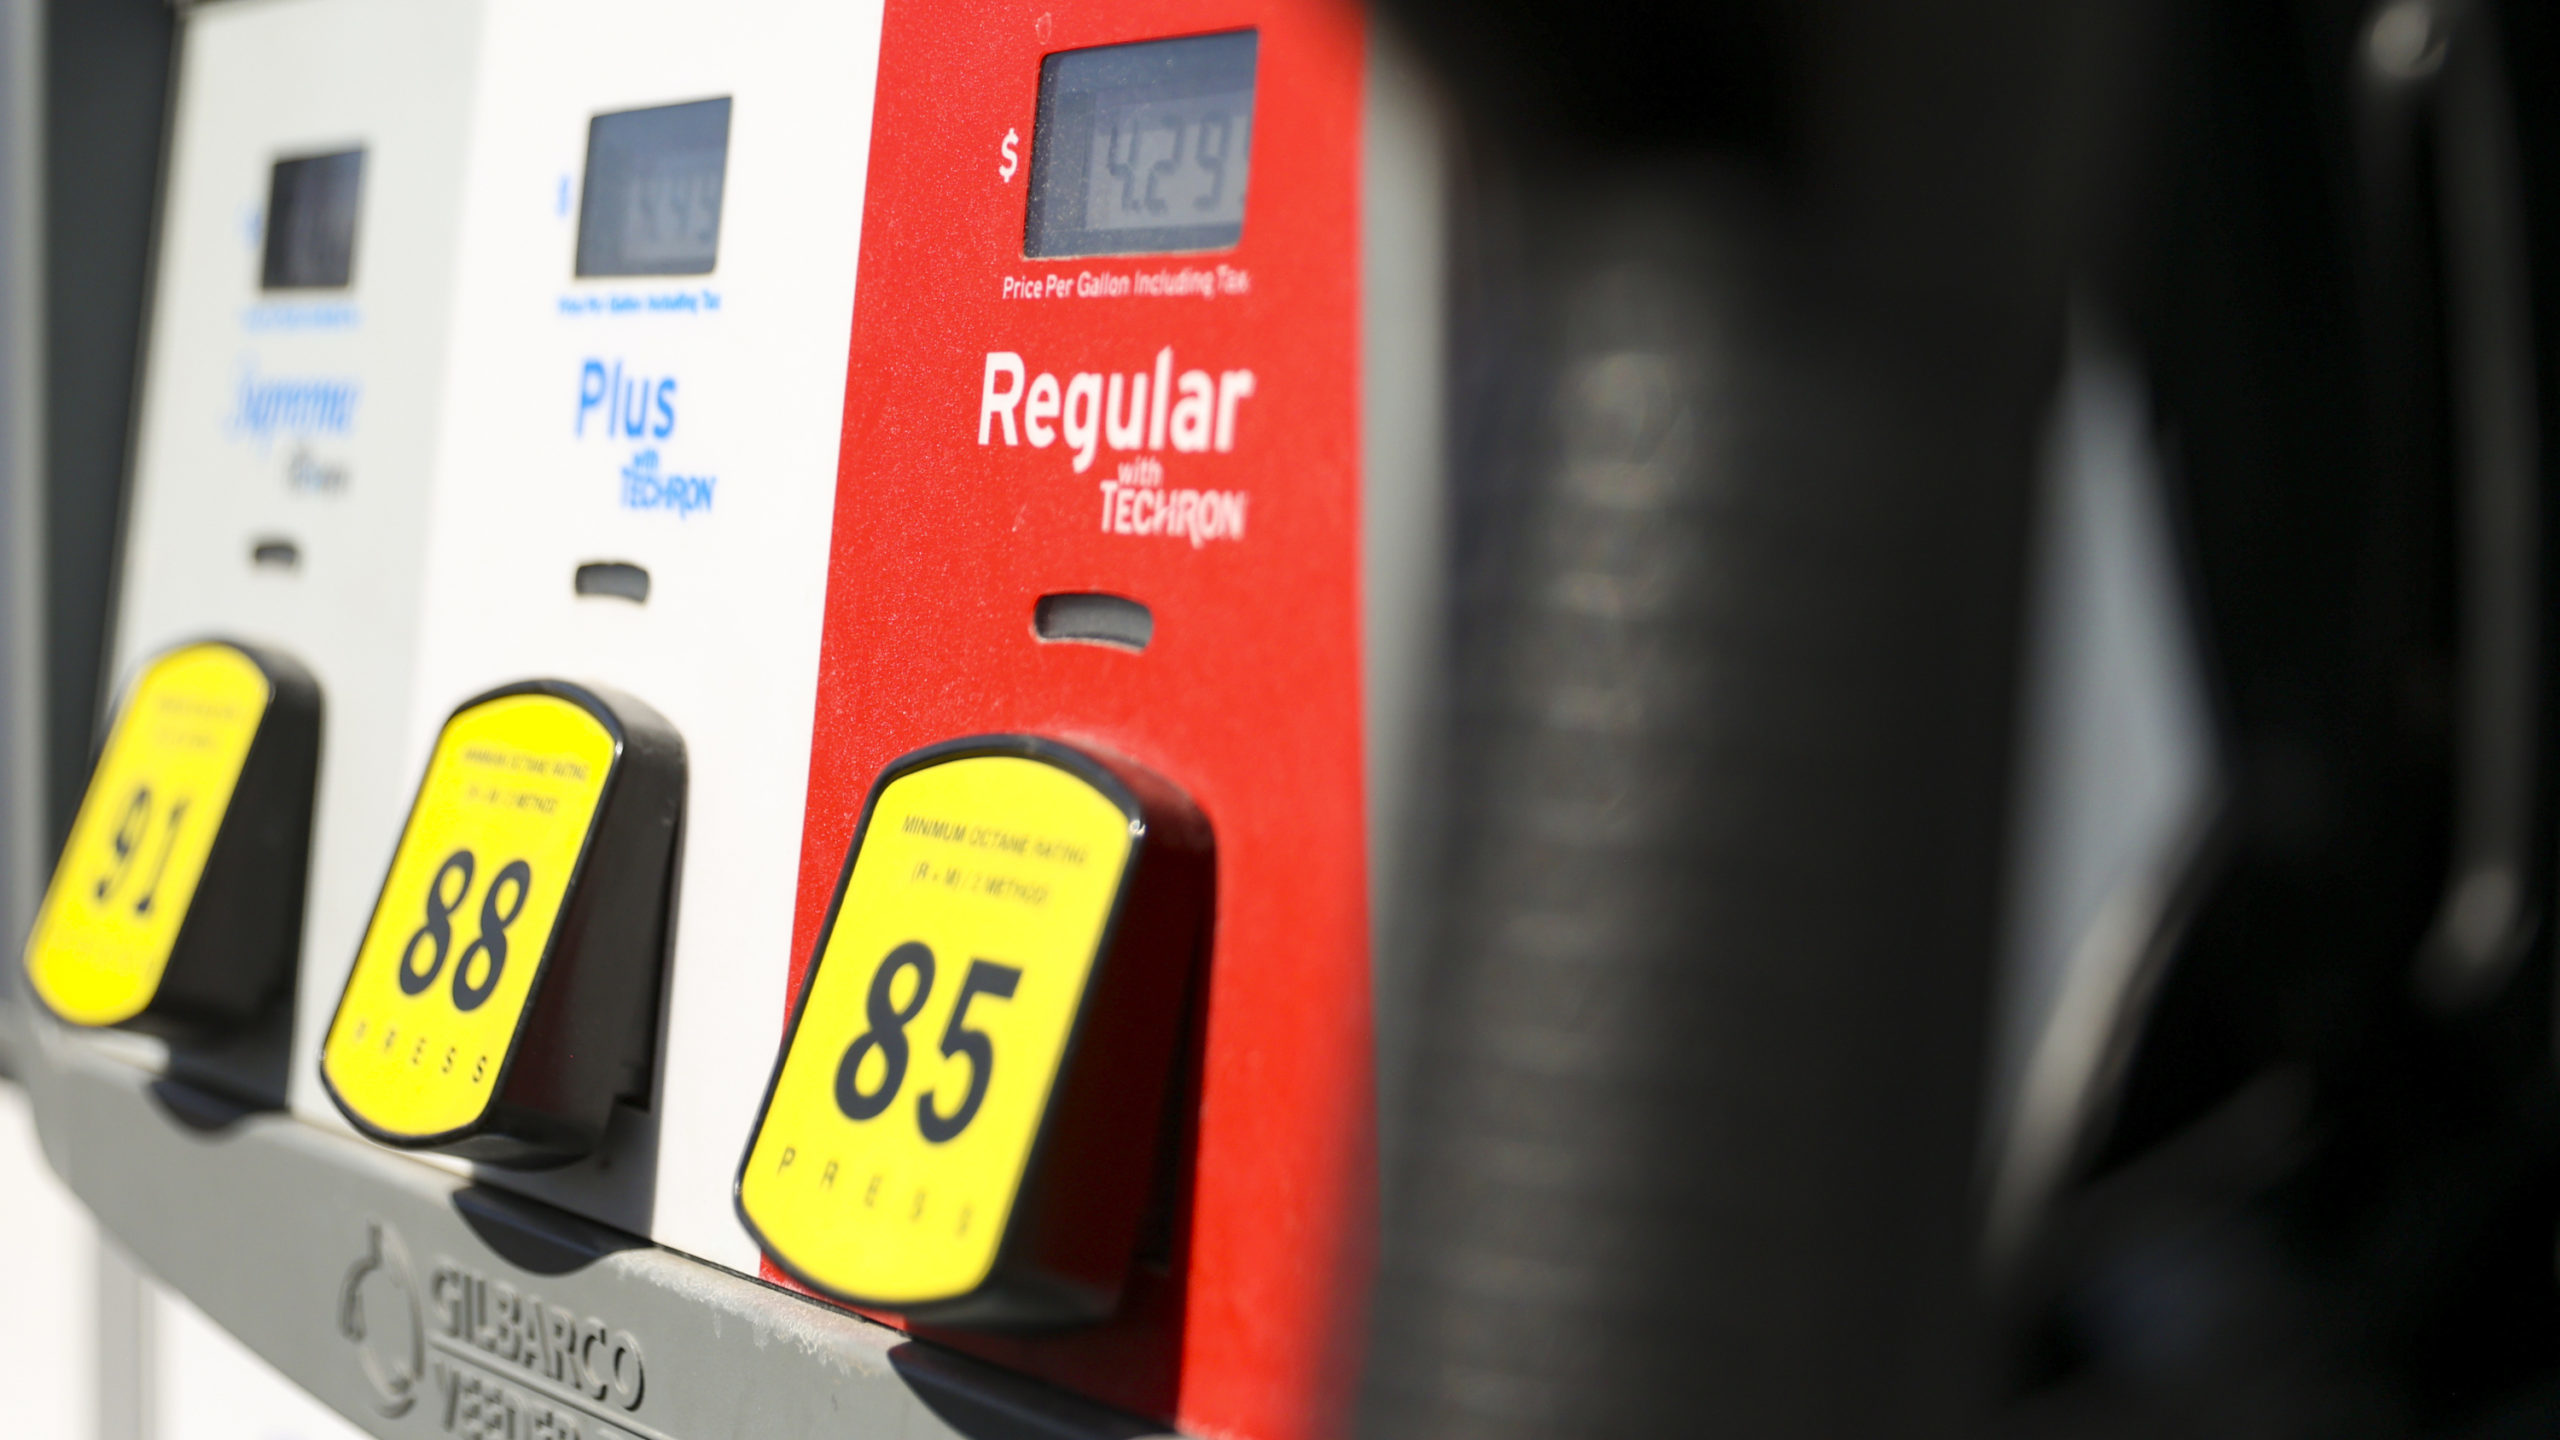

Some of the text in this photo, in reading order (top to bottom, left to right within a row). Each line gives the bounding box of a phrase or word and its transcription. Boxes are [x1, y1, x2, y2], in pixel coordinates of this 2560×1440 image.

[999, 128, 1019, 184] $
[1002, 264, 1250, 300] Price Per Gallon Including Tax
[575, 359, 678, 440] Plus
[978, 345, 1256, 474] Regular
[1117, 456, 1164, 486] with
[1099, 479, 1248, 550] TECHRON
[94, 783, 188, 917] 91
[902, 813, 967, 844] MINIMUM
[967, 825, 1030, 857] OCTANE
[398, 849, 532, 1013] 88
[833, 940, 1024, 1147] 85
[429, 1256, 646, 1414] GILBARCO
